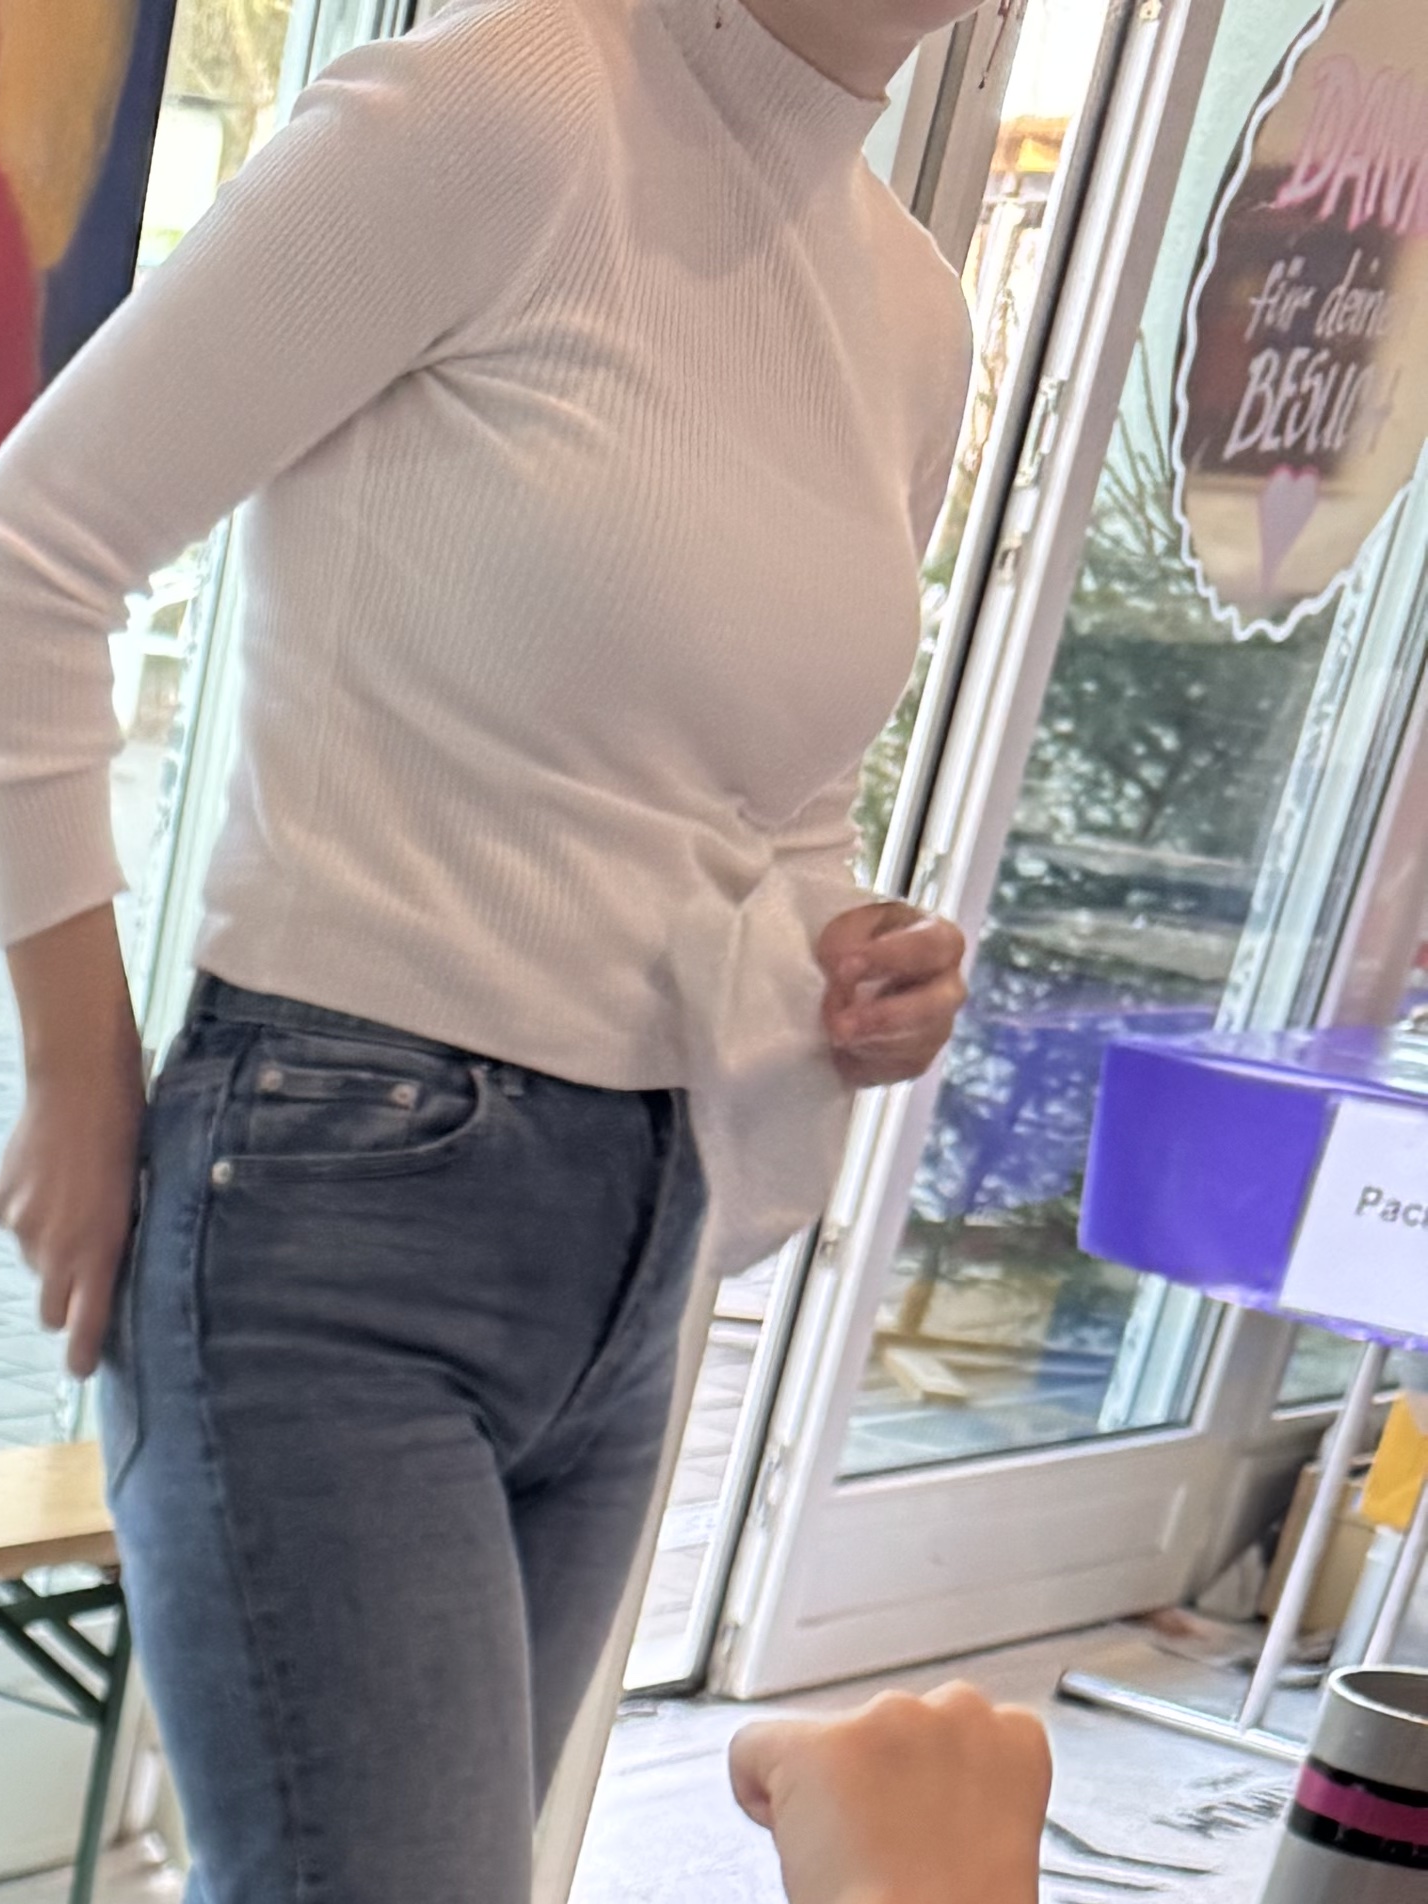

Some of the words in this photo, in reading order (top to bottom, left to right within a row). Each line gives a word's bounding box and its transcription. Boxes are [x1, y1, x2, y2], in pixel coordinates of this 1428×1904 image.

[1270, 53, 1428, 235] DAN
[1244, 256, 1318, 344] für
[1353, 1185, 1428, 1232] Pac
